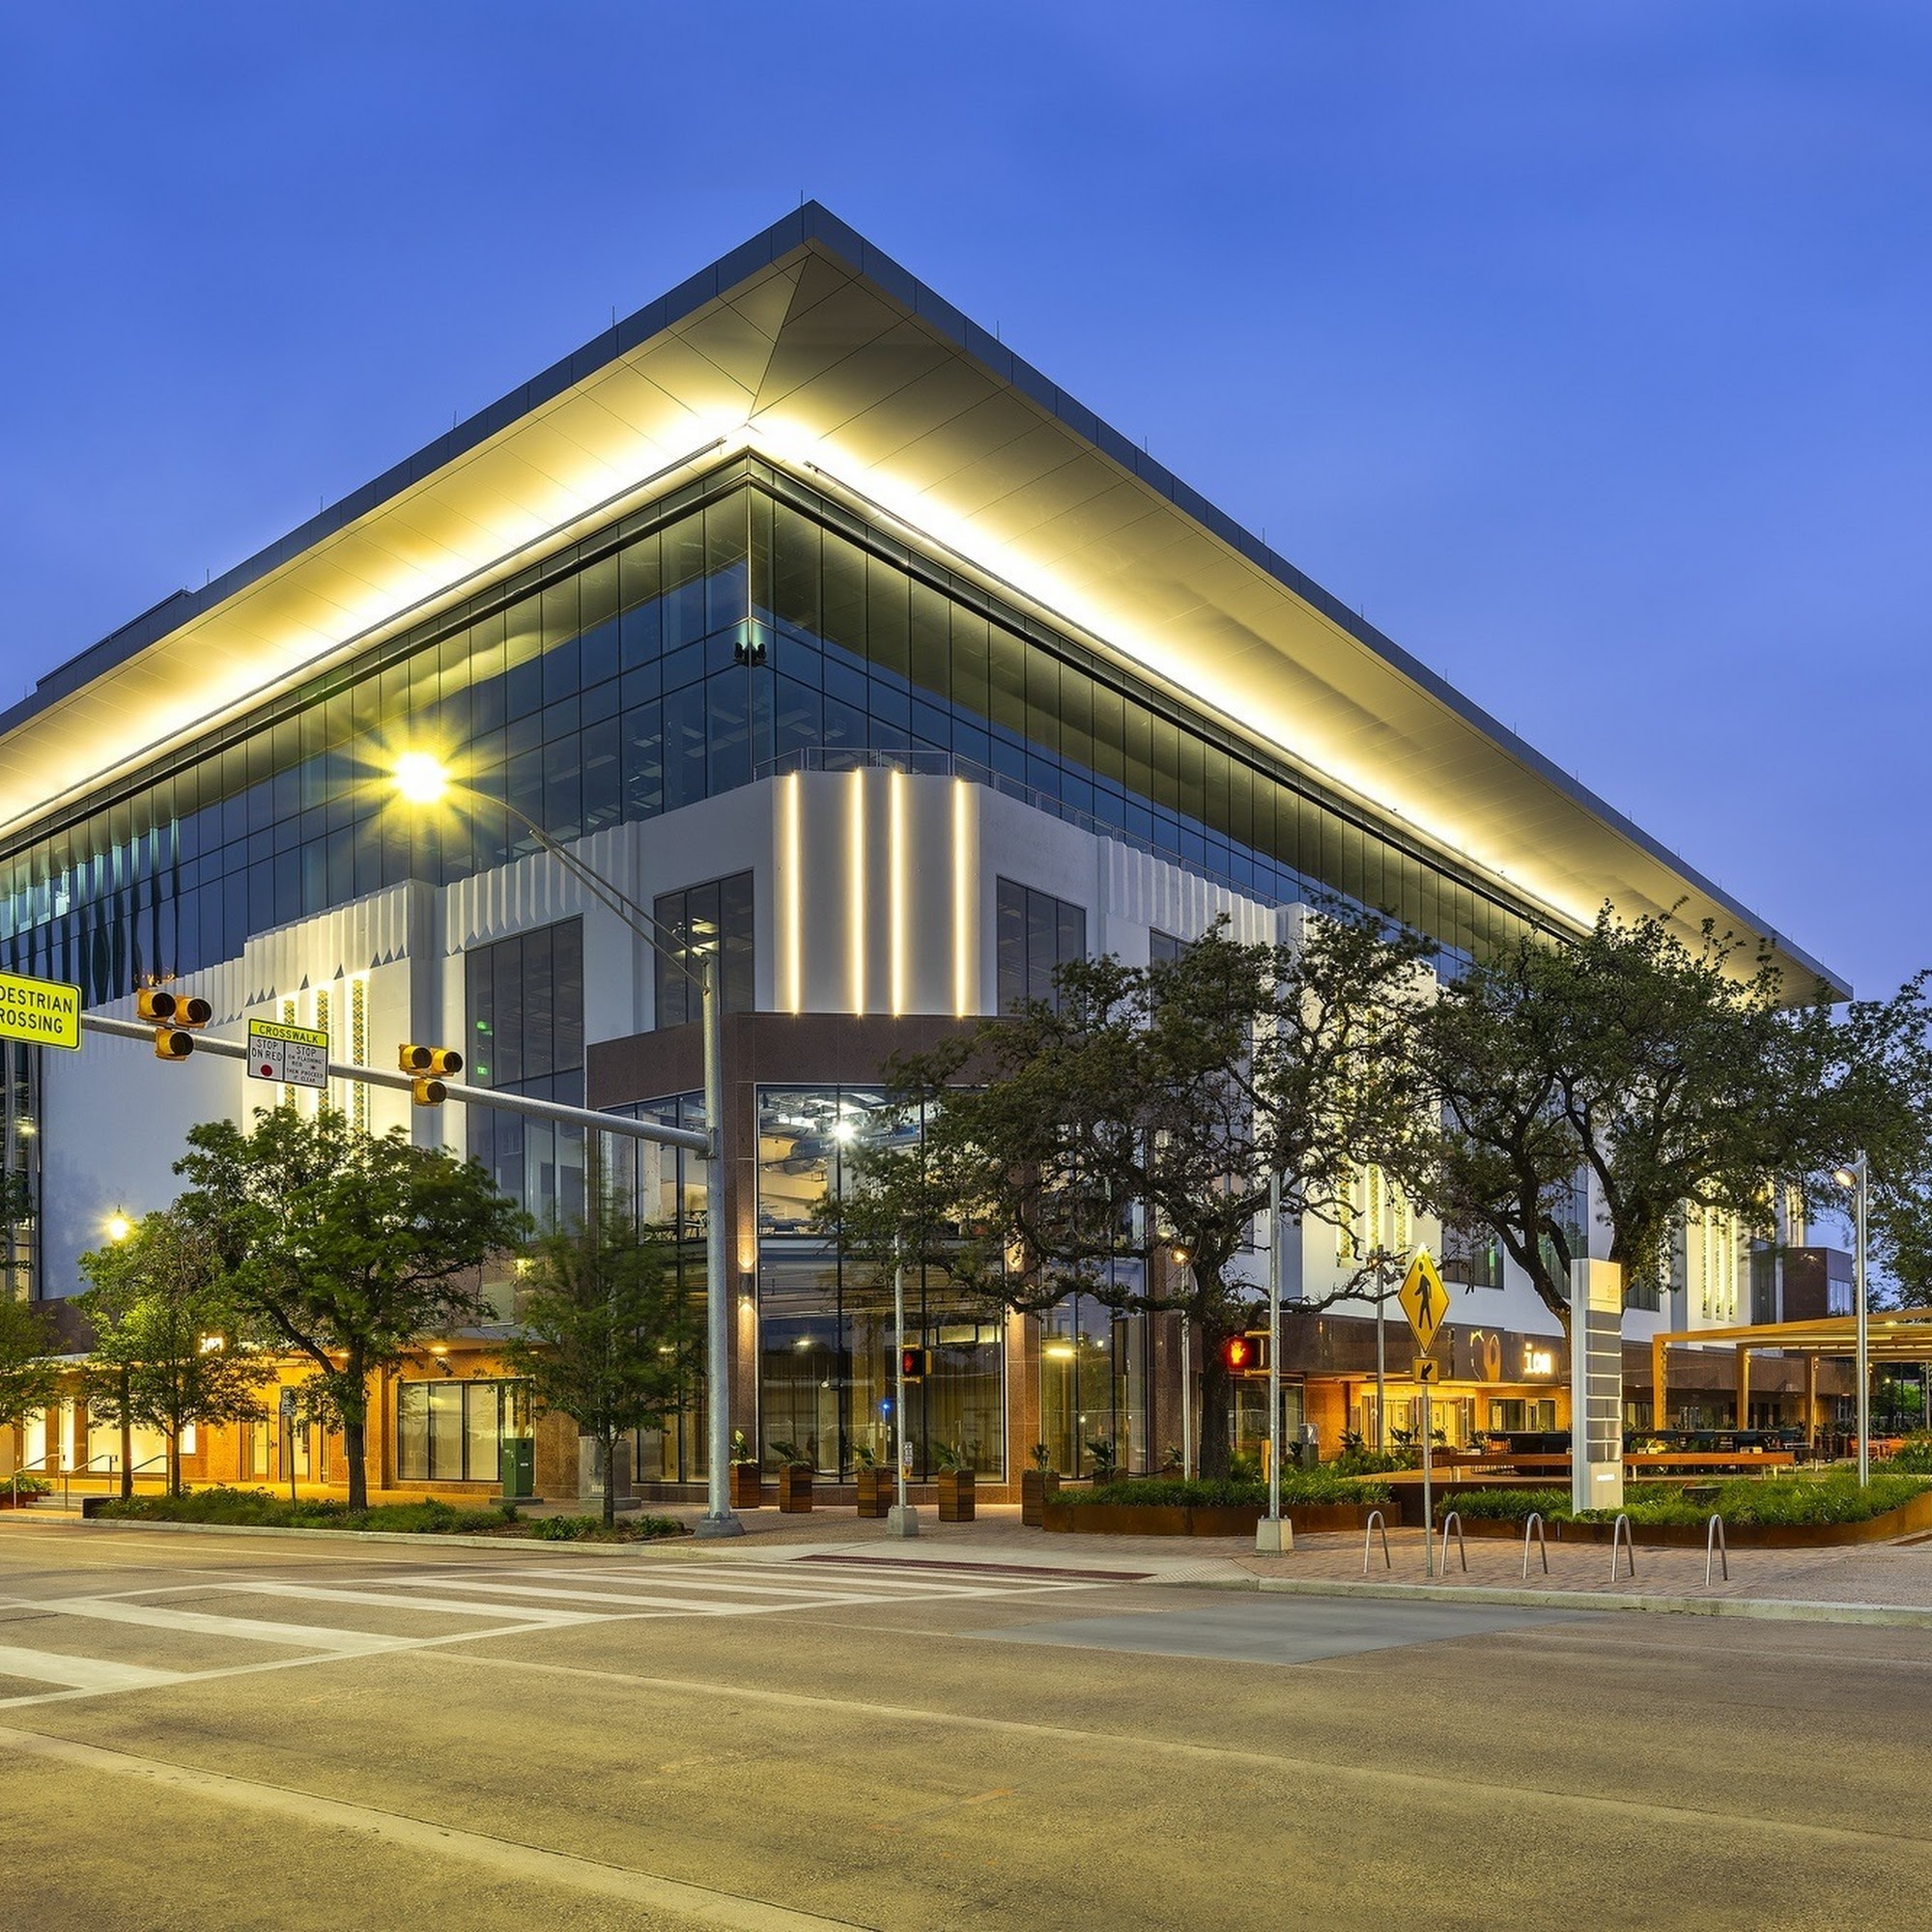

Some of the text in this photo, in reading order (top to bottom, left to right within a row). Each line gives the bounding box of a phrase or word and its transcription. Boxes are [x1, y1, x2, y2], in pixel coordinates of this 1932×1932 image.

[0, 985, 72, 1013] DESTRIAN
[259, 1025, 319, 1044] CROSSWALK
[256, 1038, 278, 1050] STOP
[296, 1046, 317, 1057] STOP
[251, 1047, 283, 1062] ON RED
